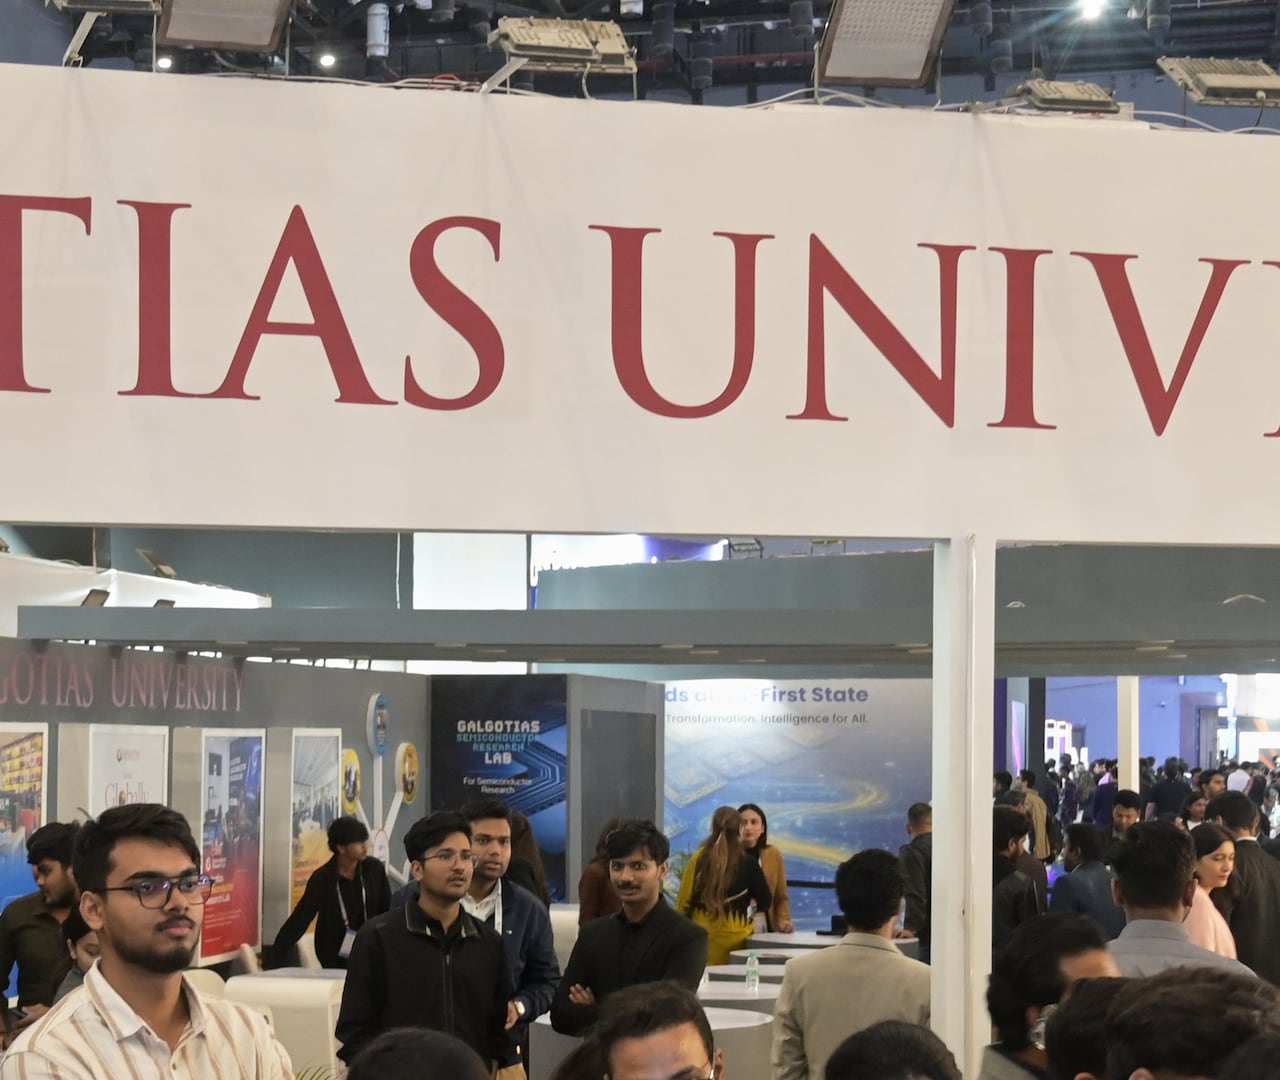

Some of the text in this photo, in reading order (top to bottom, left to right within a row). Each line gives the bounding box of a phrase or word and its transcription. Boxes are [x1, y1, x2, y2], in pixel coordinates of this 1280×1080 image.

[111, 657, 247, 712] UNIVERSITY
[812, 687, 869, 702] State
[761, 713, 829, 726] Intelligence
[832, 713, 848, 724] for
[851, 713, 869, 724] All.
[457, 720, 540, 733] GALGOTIAS
[473, 742, 525, 752] RESEARCH
[484, 752, 513, 765] LAB
[463, 777, 533, 786] For Semiconductor
[480, 786, 516, 794] Research
